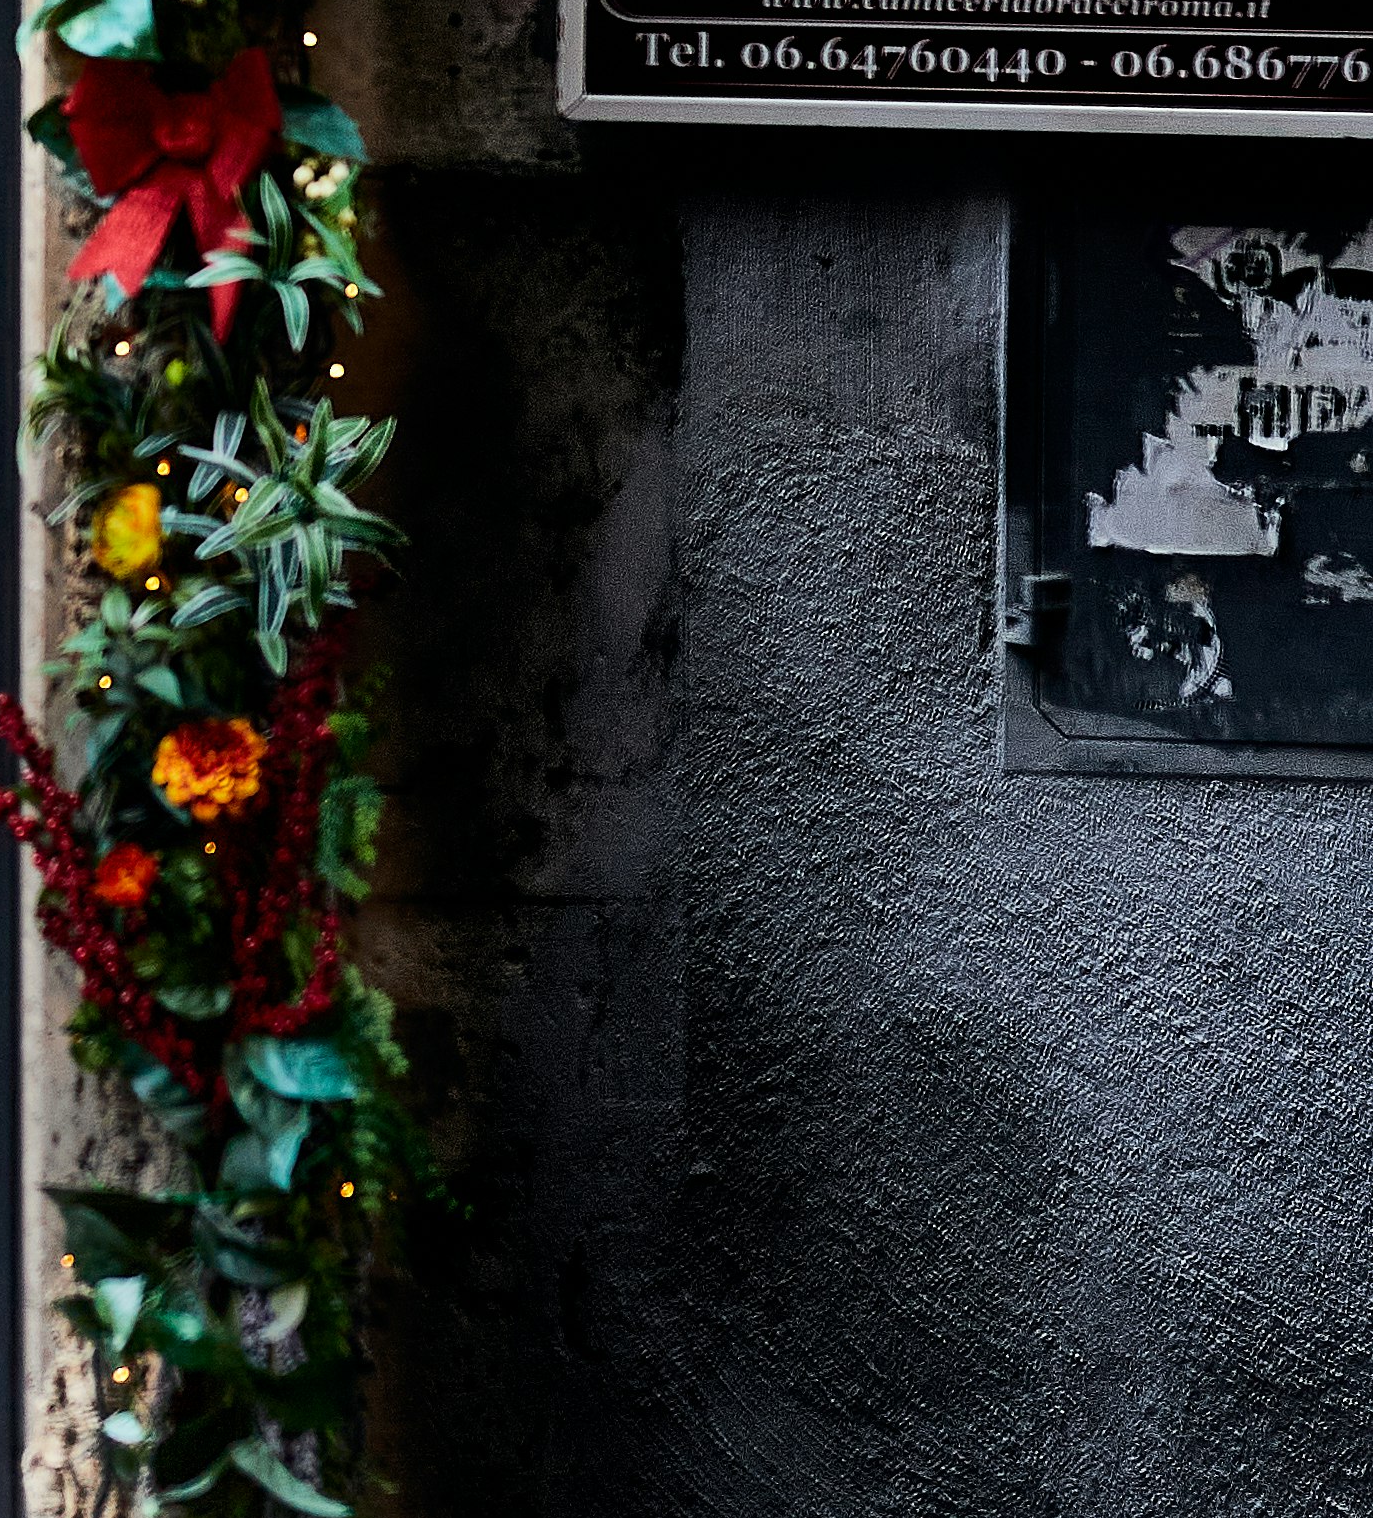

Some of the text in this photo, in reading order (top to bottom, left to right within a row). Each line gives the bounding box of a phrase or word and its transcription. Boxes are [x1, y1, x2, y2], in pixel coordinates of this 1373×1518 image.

[636, 32, 724, 67] Tel.
[740, 36, 1066, 83] 06.64760440
[1111, 44, 1372, 90] 06.686776
